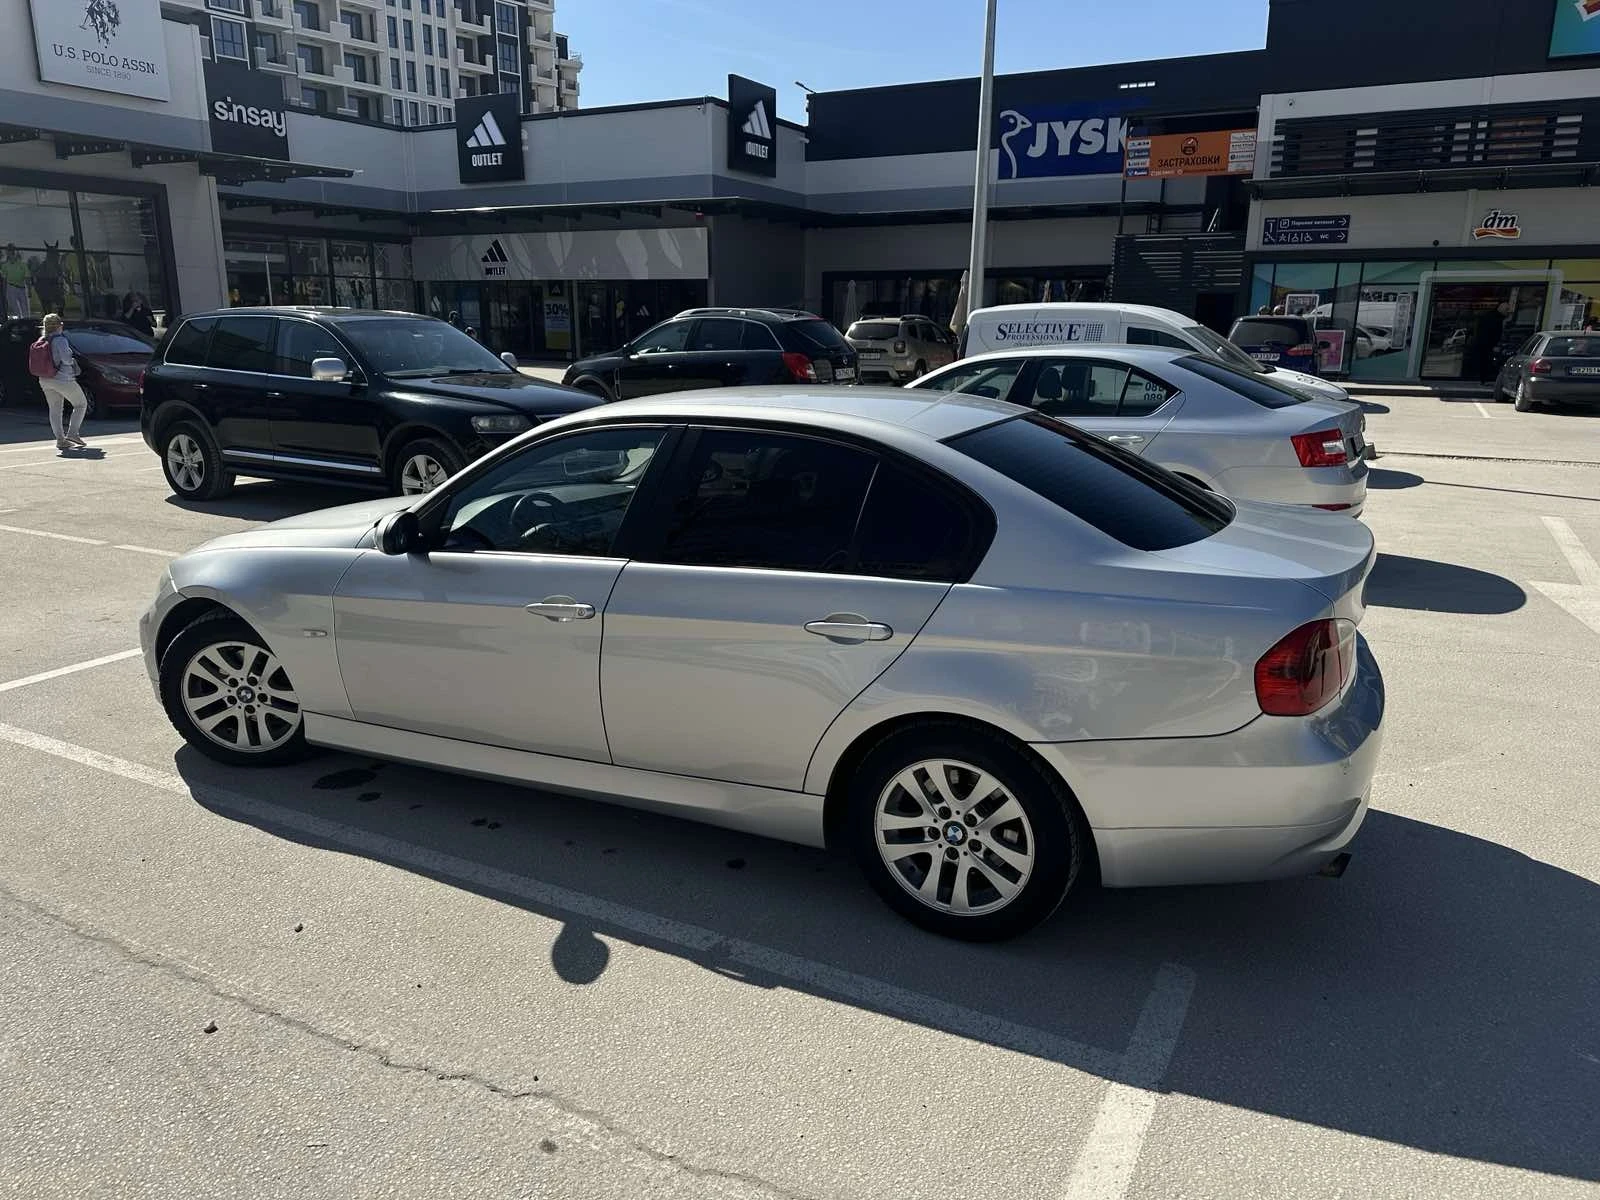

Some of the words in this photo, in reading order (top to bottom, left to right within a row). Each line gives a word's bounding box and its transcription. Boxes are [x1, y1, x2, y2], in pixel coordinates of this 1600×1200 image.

[53, 43, 80, 60] U.S.
[82, 49, 119, 67] POLO
[122, 57, 159, 75] ASSN.
[86, 65, 111, 77] SINCE
[214, 96, 286, 137] sinsay
[1026, 117, 1128, 158] JYSK
[745, 141, 769, 159] OUTLET
[471, 152, 503, 167] OUTLET
[1157, 155, 1221, 168] ЗАСТРАХОВКИ
[1482, 210, 1518, 229] dm
[485, 266, 506, 276] OUTLET
[545, 303, 569, 315] 30%
[1006, 333, 1063, 341] PROFESSIONAL
